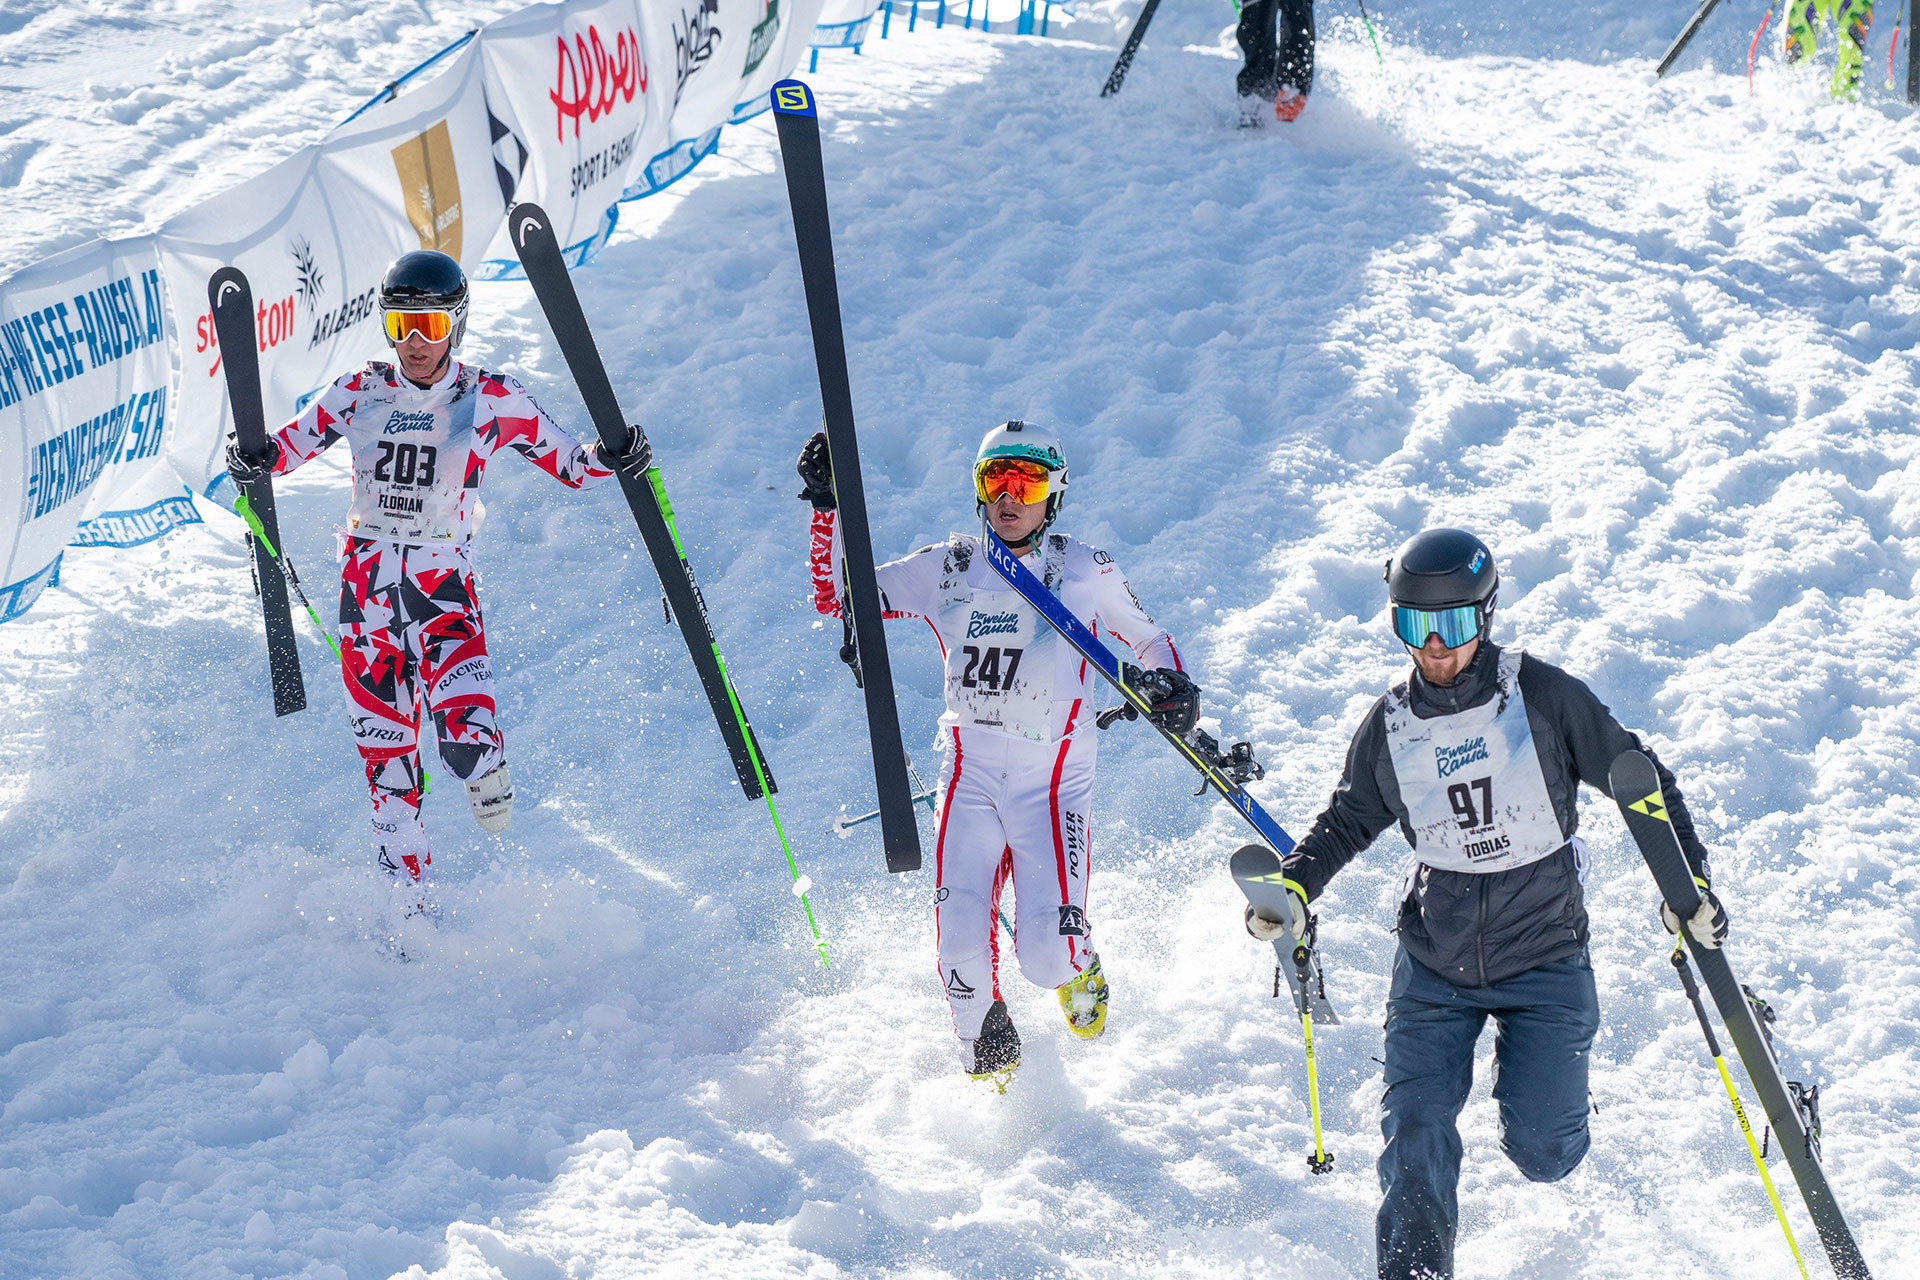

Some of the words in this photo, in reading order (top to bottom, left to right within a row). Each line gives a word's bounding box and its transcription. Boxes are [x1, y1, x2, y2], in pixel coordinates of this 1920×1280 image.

[571, 152, 601, 198] SPORT
[308, 287, 375, 351] ARLBERG
[383, 419, 435, 435] Rausch
[374, 440, 437, 487] 203
[378, 494, 423, 513] FLORIAN
[989, 538, 1018, 578] RACE
[966, 619, 1020, 639] Rausch
[438, 659, 485, 691] RACING
[962, 645, 1024, 691] 247
[349, 715, 404, 742] USTRIA
[1437, 743, 1490, 778] Rausch
[1447, 776, 1493, 830] 97
[1066, 811, 1079, 880] POWER
[1077, 814, 1085, 853] TEAM
[1465, 835, 1511, 859] TOBIAS
